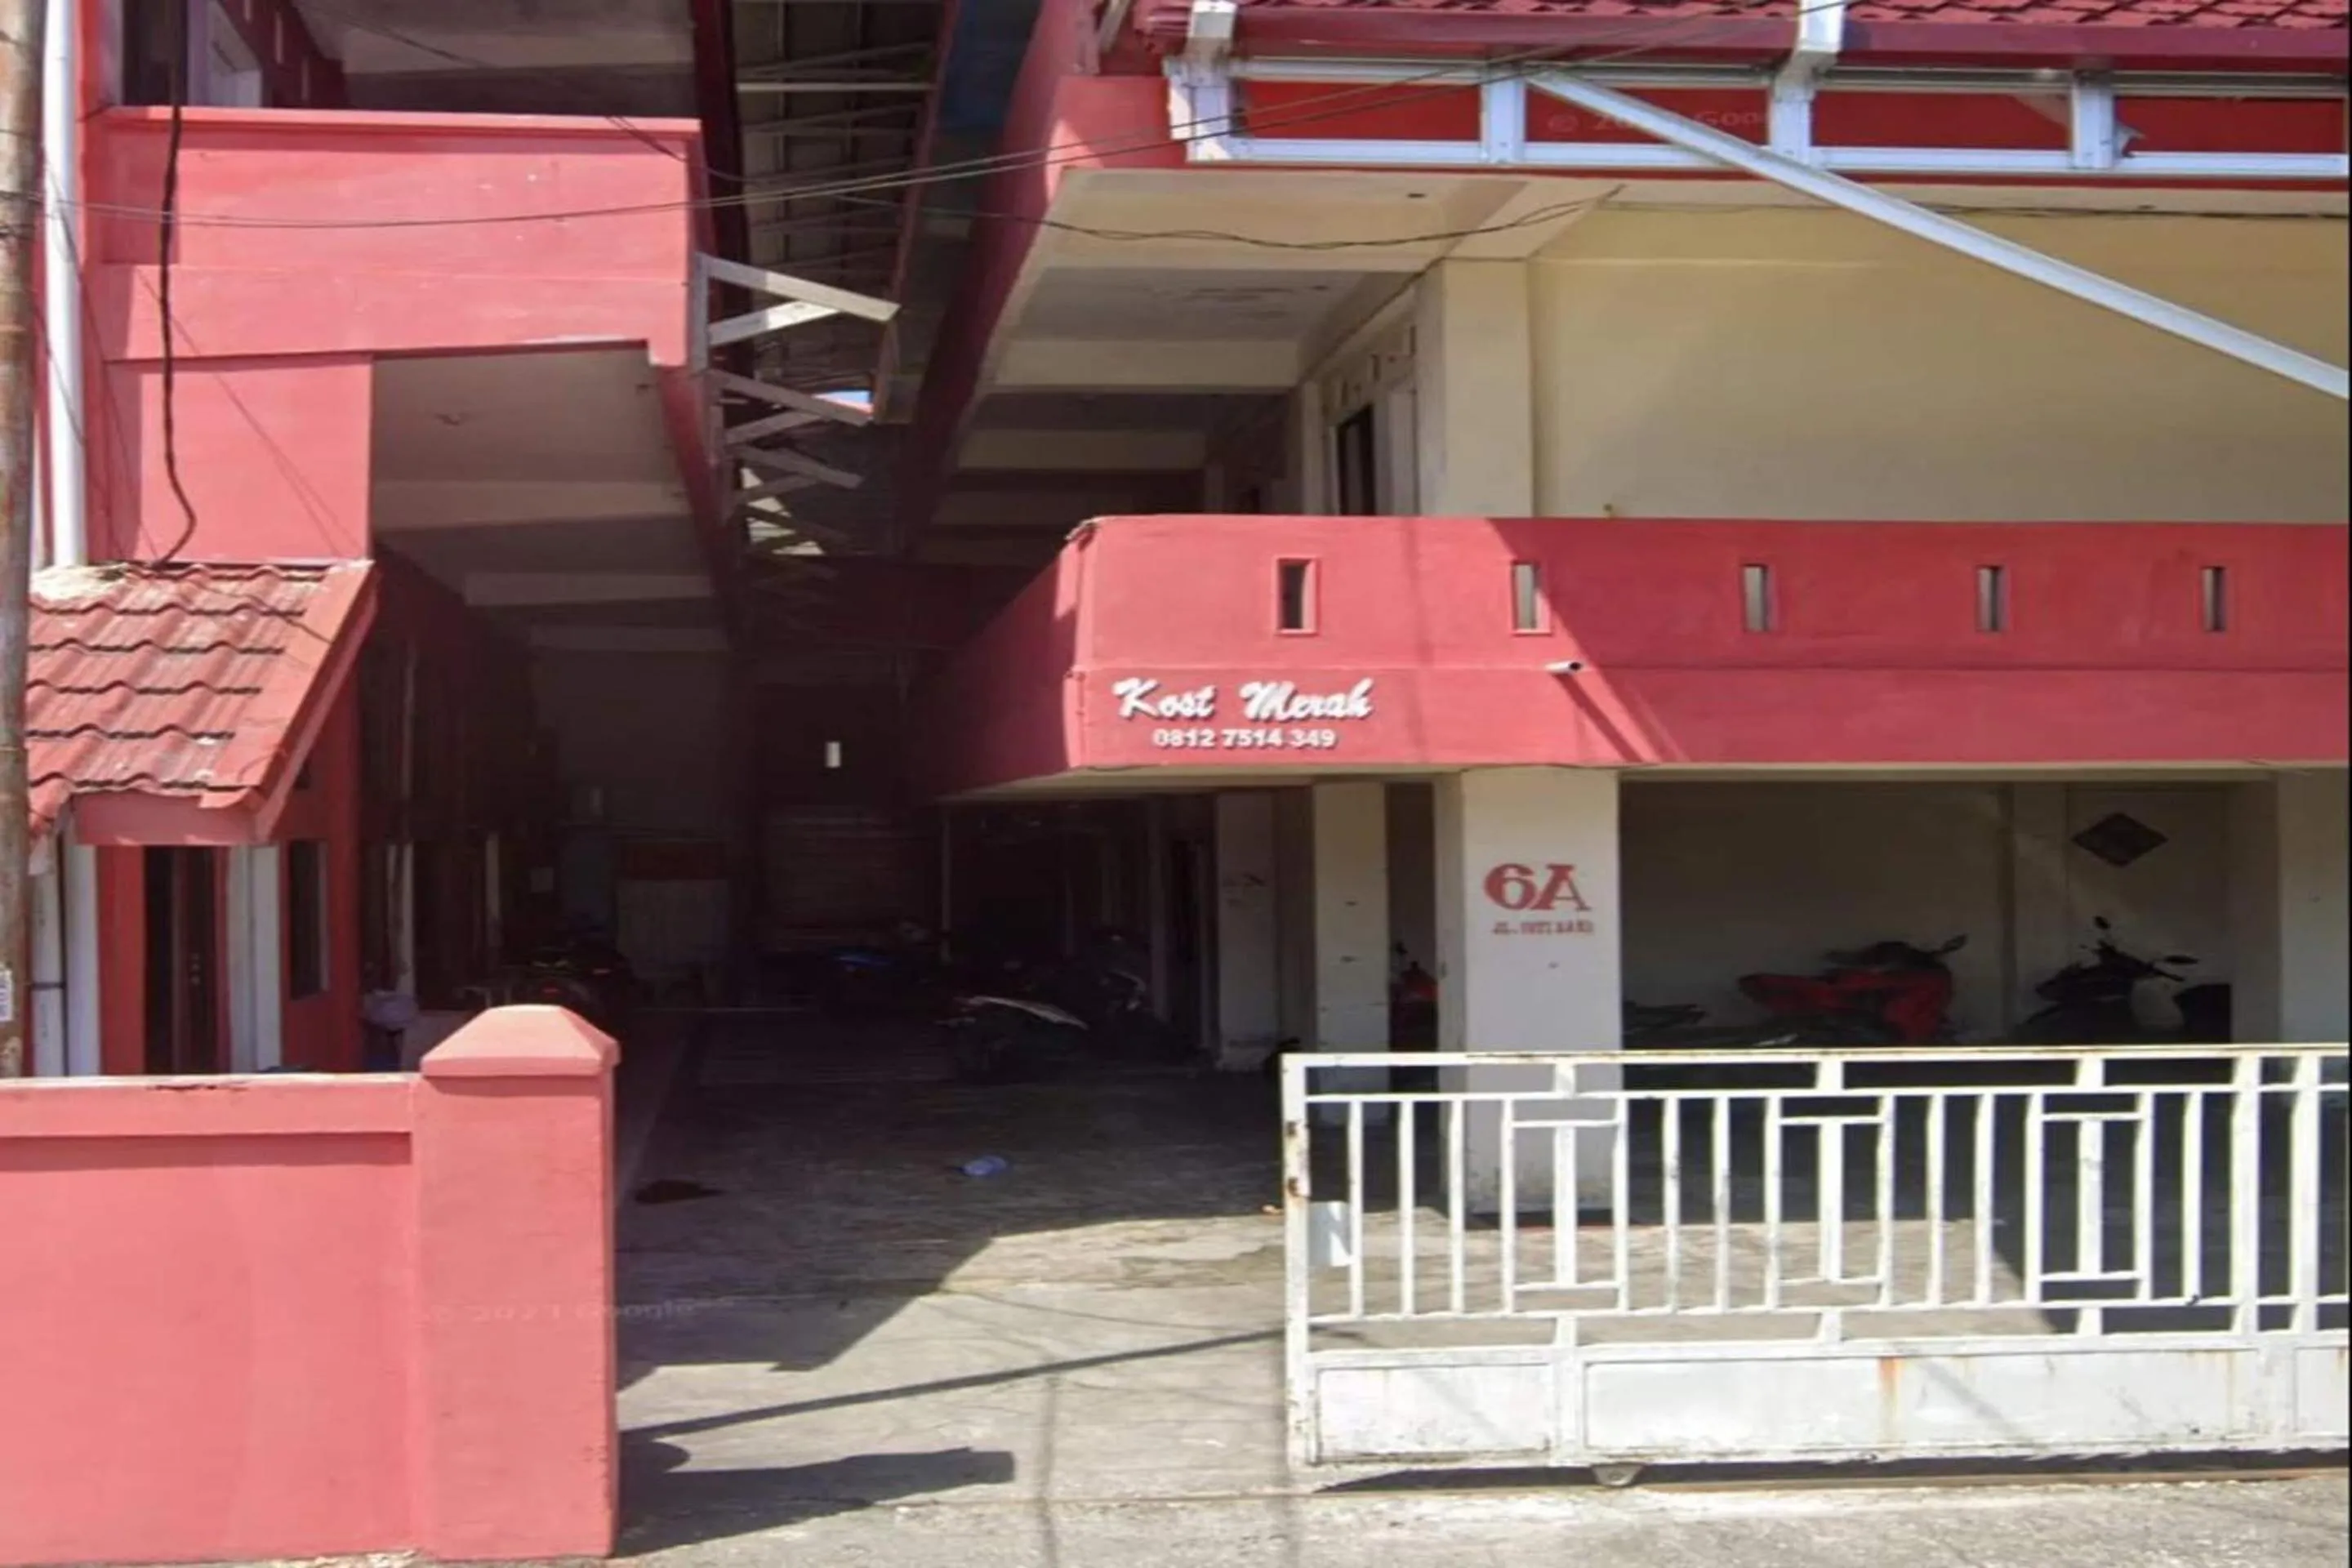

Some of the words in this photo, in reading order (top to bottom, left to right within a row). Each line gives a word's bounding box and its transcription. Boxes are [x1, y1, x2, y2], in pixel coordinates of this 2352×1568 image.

[1111, 677, 1217, 719] Kost
[1239, 678, 1374, 723] Merah
[1152, 728, 1216, 748] 0812
[1221, 728, 1284, 748] 7514
[1289, 728, 1338, 749] 349
[1483, 862, 1592, 911] 6A
